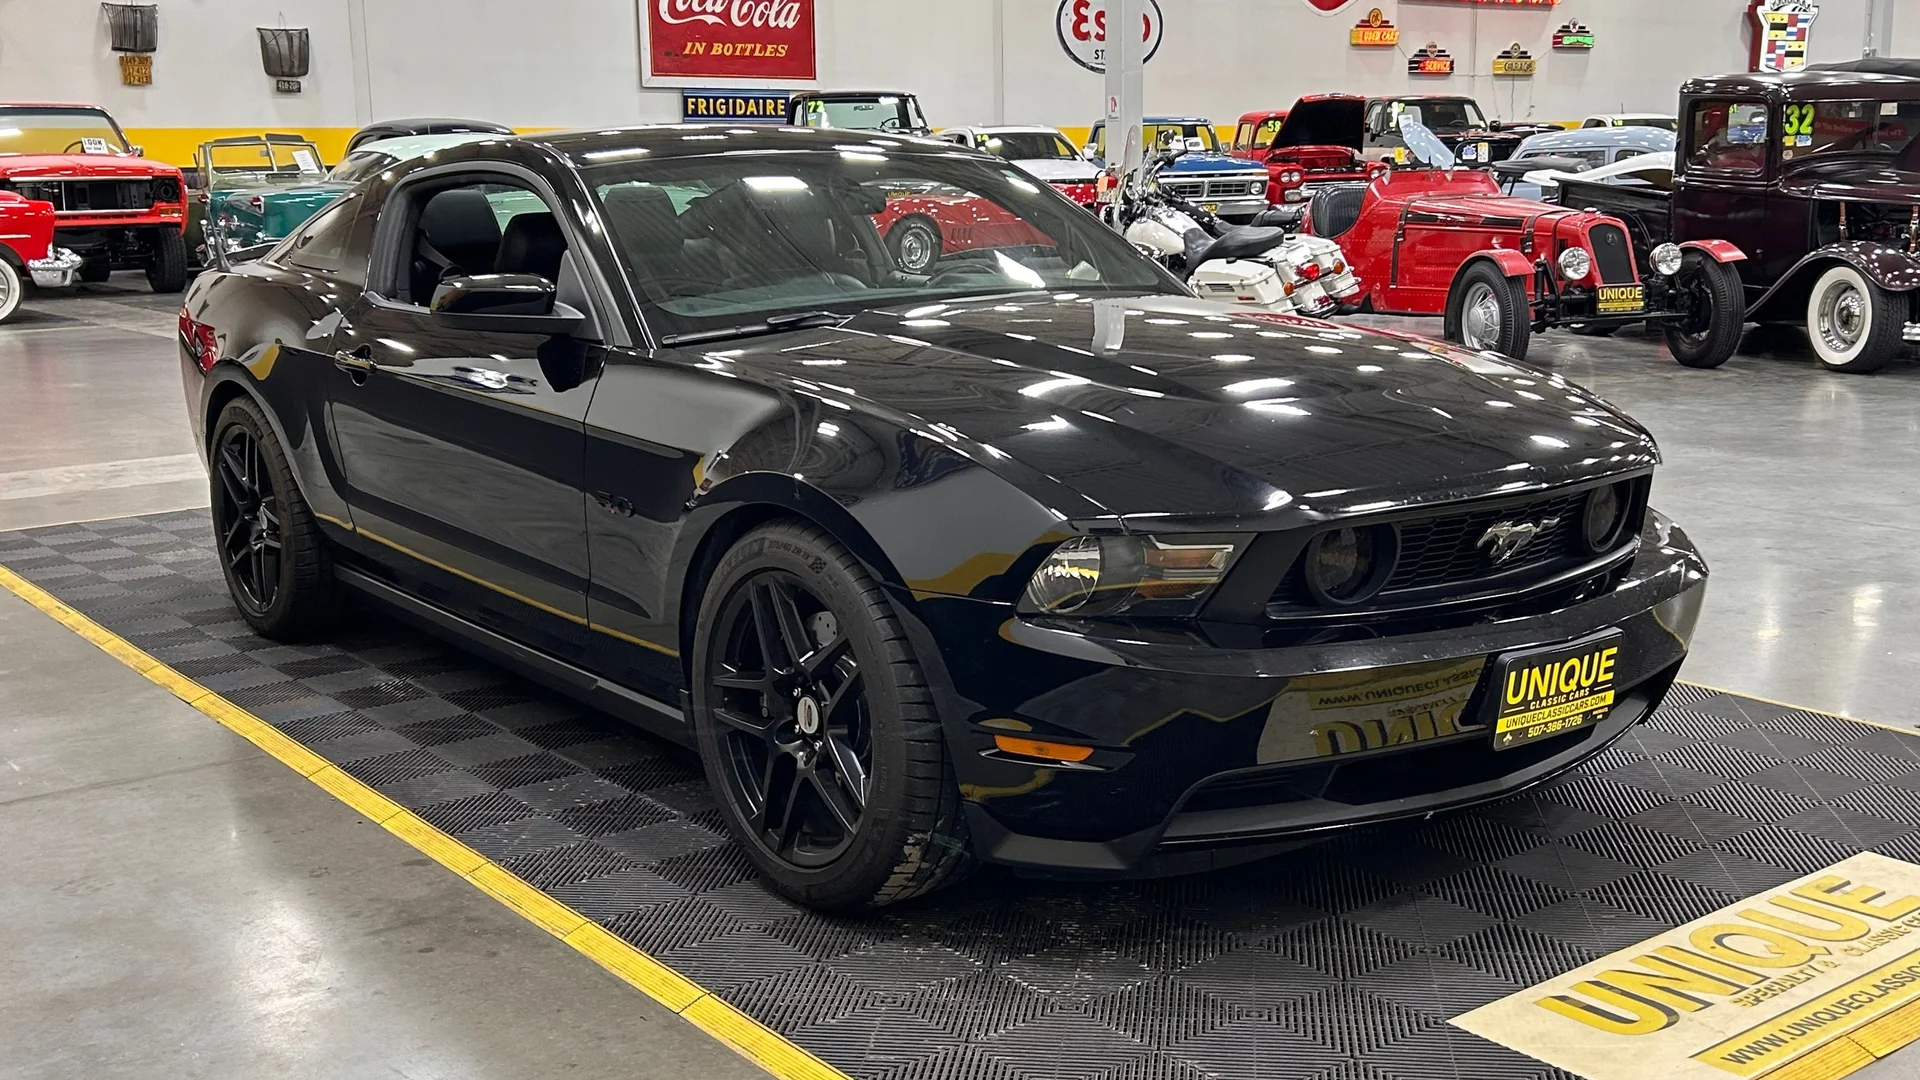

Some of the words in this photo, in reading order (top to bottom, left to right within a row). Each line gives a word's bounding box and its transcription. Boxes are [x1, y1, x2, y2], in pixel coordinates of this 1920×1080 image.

[682, 42, 706, 55] IN
[710, 43, 788, 57] BOTTLES
[687, 98, 786, 116] FRIGIDAIRE
[808, 101, 825, 113] 72
[1268, 120, 1281, 132] 58
[1784, 103, 1815, 135] 32
[977, 134, 990, 142] 14
[1598, 286, 1643, 300] UNIQUE
[1506, 646, 1618, 705] UNIQUE
[1529, 695, 1567, 710] CLASSIC
[1568, 687, 1590, 701] CARS
[1506, 694, 1607, 729] UNIQUECLASSICCARS.COM
[1534, 875, 1920, 1036] UNIQUE
[1729, 963, 1825, 1008] SPECIALTY
[1839, 925, 1912, 957] CLASSIC
